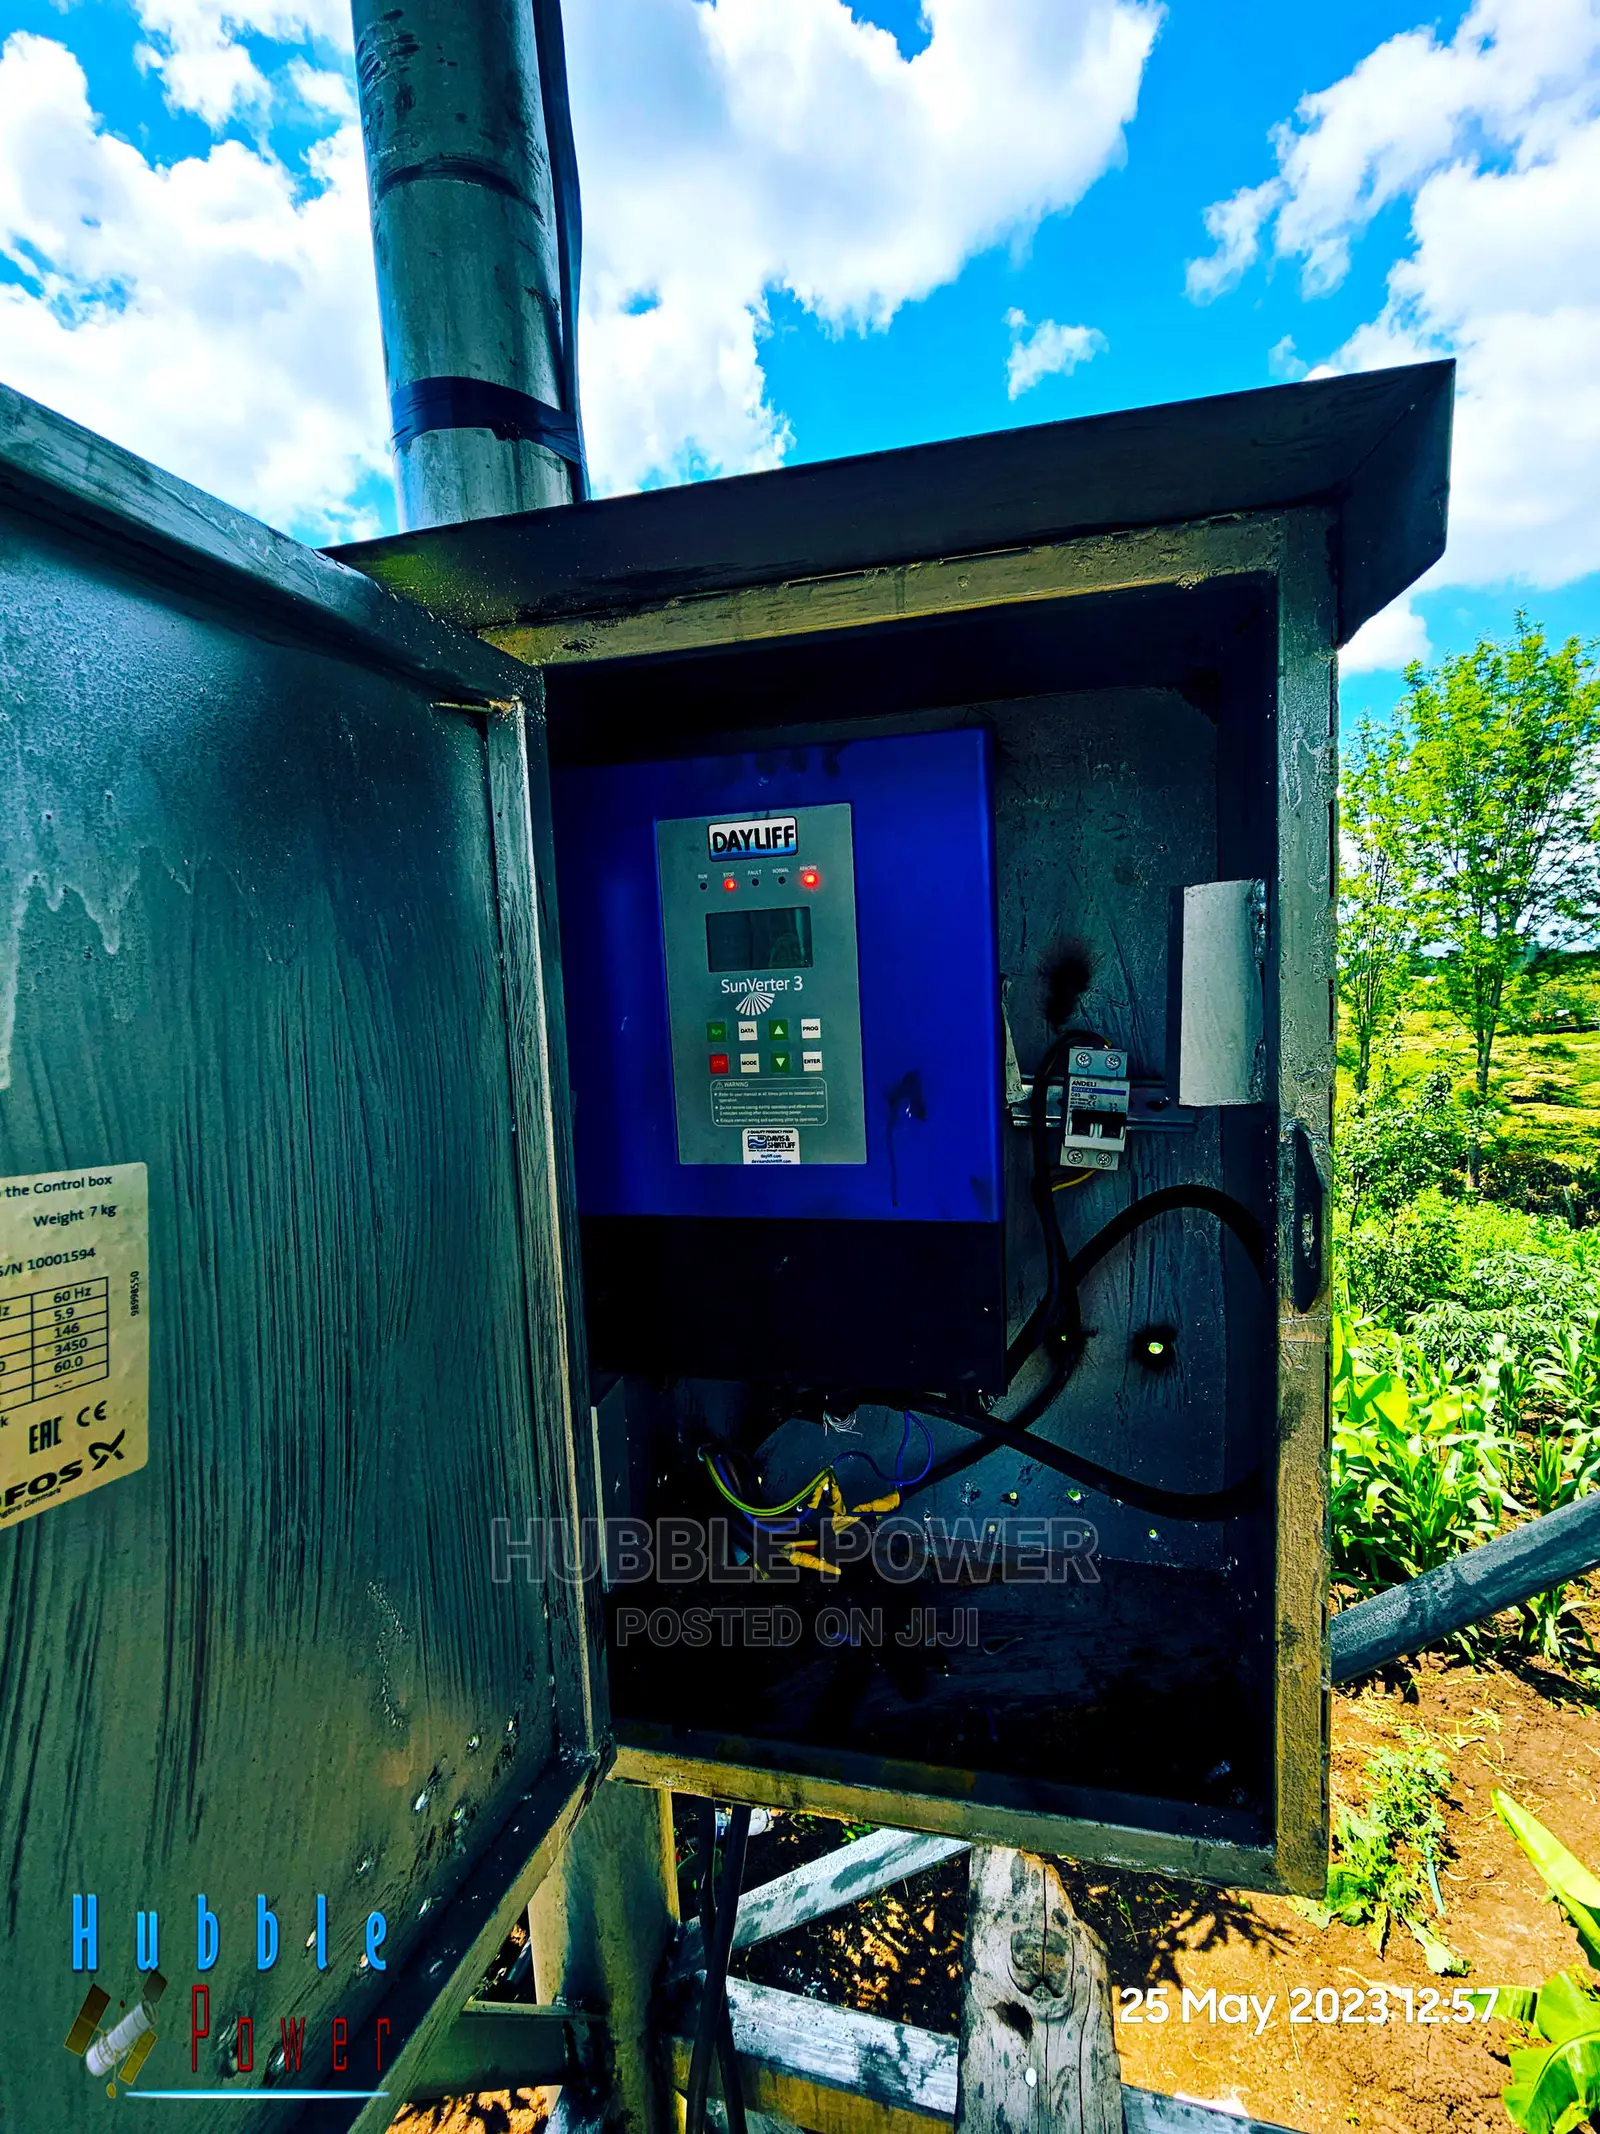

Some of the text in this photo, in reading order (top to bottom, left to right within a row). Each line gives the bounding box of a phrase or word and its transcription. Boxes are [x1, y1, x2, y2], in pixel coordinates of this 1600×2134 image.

[712, 825, 795, 853] DAYLIFF
[721, 976, 803, 993] SunVerter 3
[5, 1175, 113, 1198] the Control box
[33, 1204, 118, 1227] Weight 7 kg
[28, 1247, 96, 1271] 10001594
[53, 1290, 71, 1303] 60
[74, 1286, 92, 1299] Hz
[53, 1307, 75, 1322] 5.9
[54, 1323, 80, 1339] 146
[54, 1337, 88, 1357] 3450
[54, 1356, 83, 1373] 60.0
